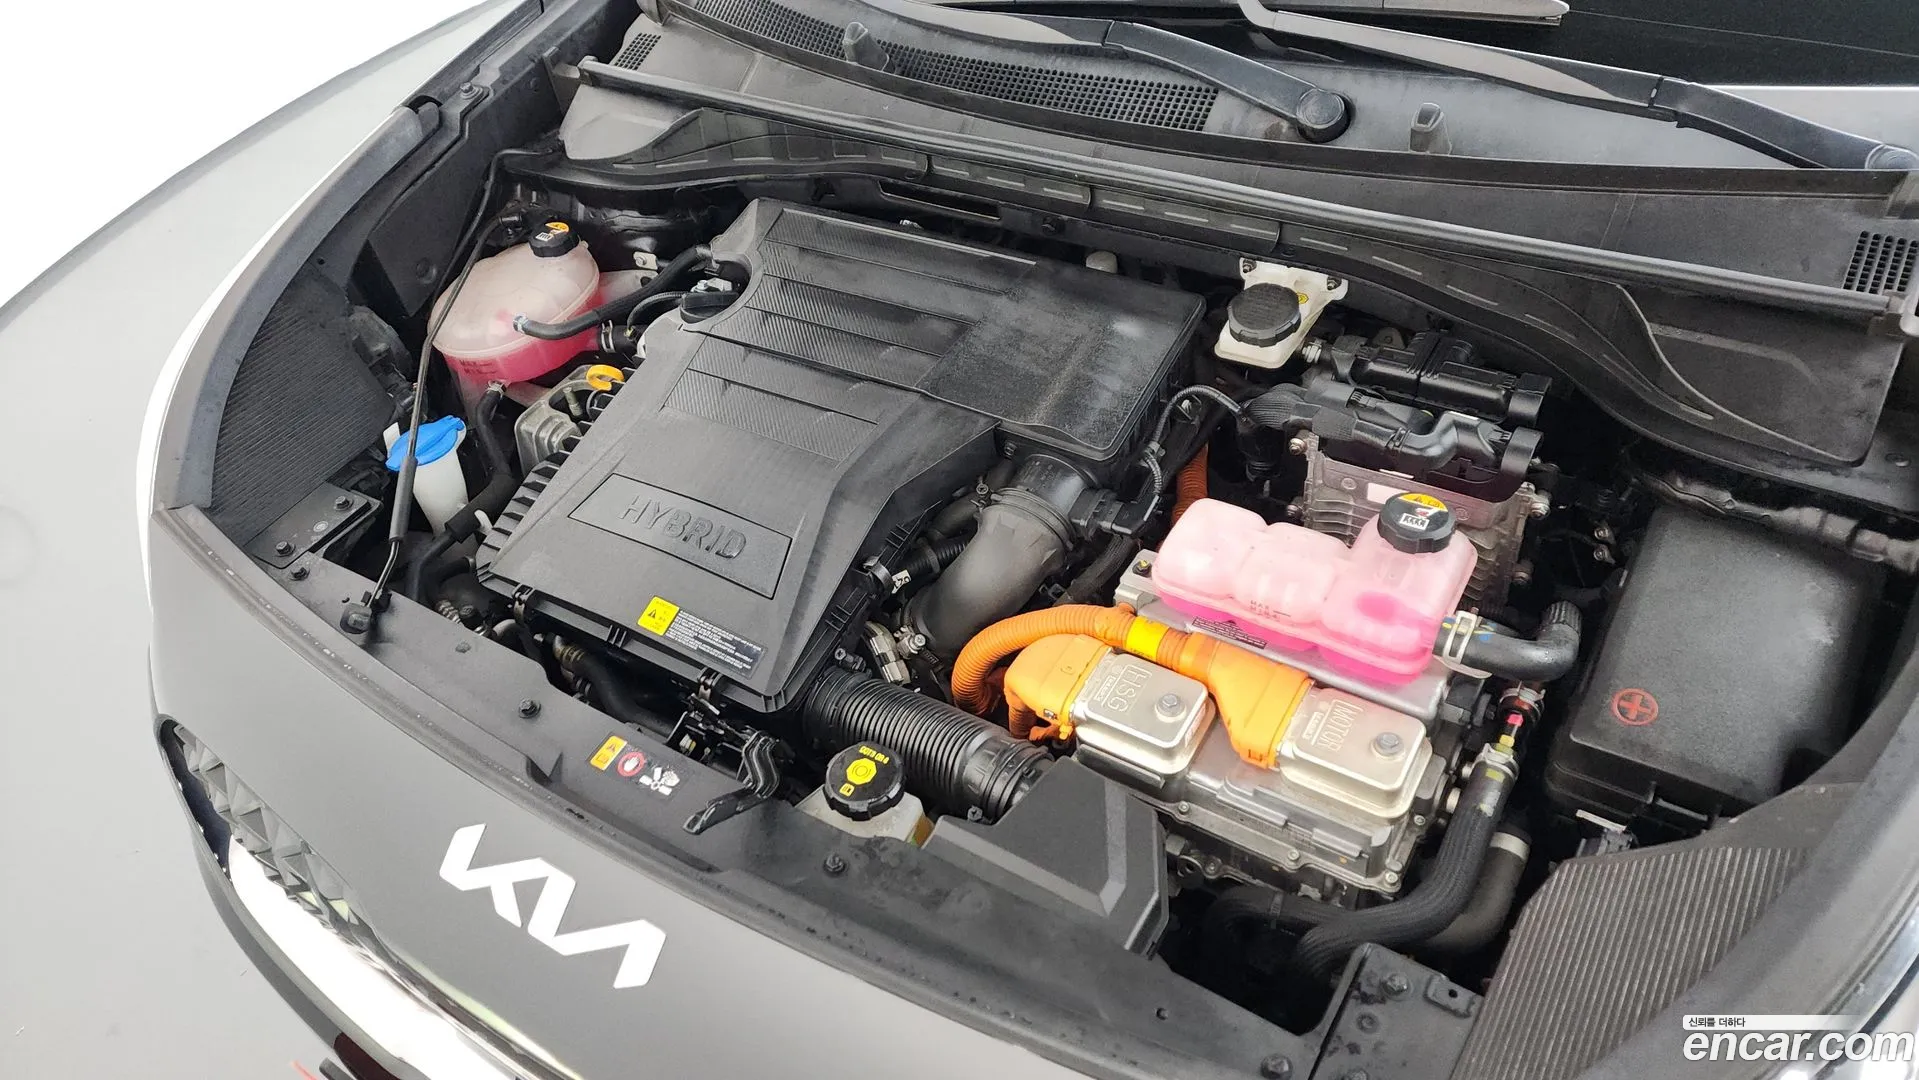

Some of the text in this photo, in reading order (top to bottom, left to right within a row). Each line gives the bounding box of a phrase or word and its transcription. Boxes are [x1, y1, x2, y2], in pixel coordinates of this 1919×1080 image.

[619, 495, 747, 559] HYBRID
[1107, 669, 1147, 712] HSG
[1317, 703, 1358, 753] MOTOR
[440, 823, 667, 989] KIA
